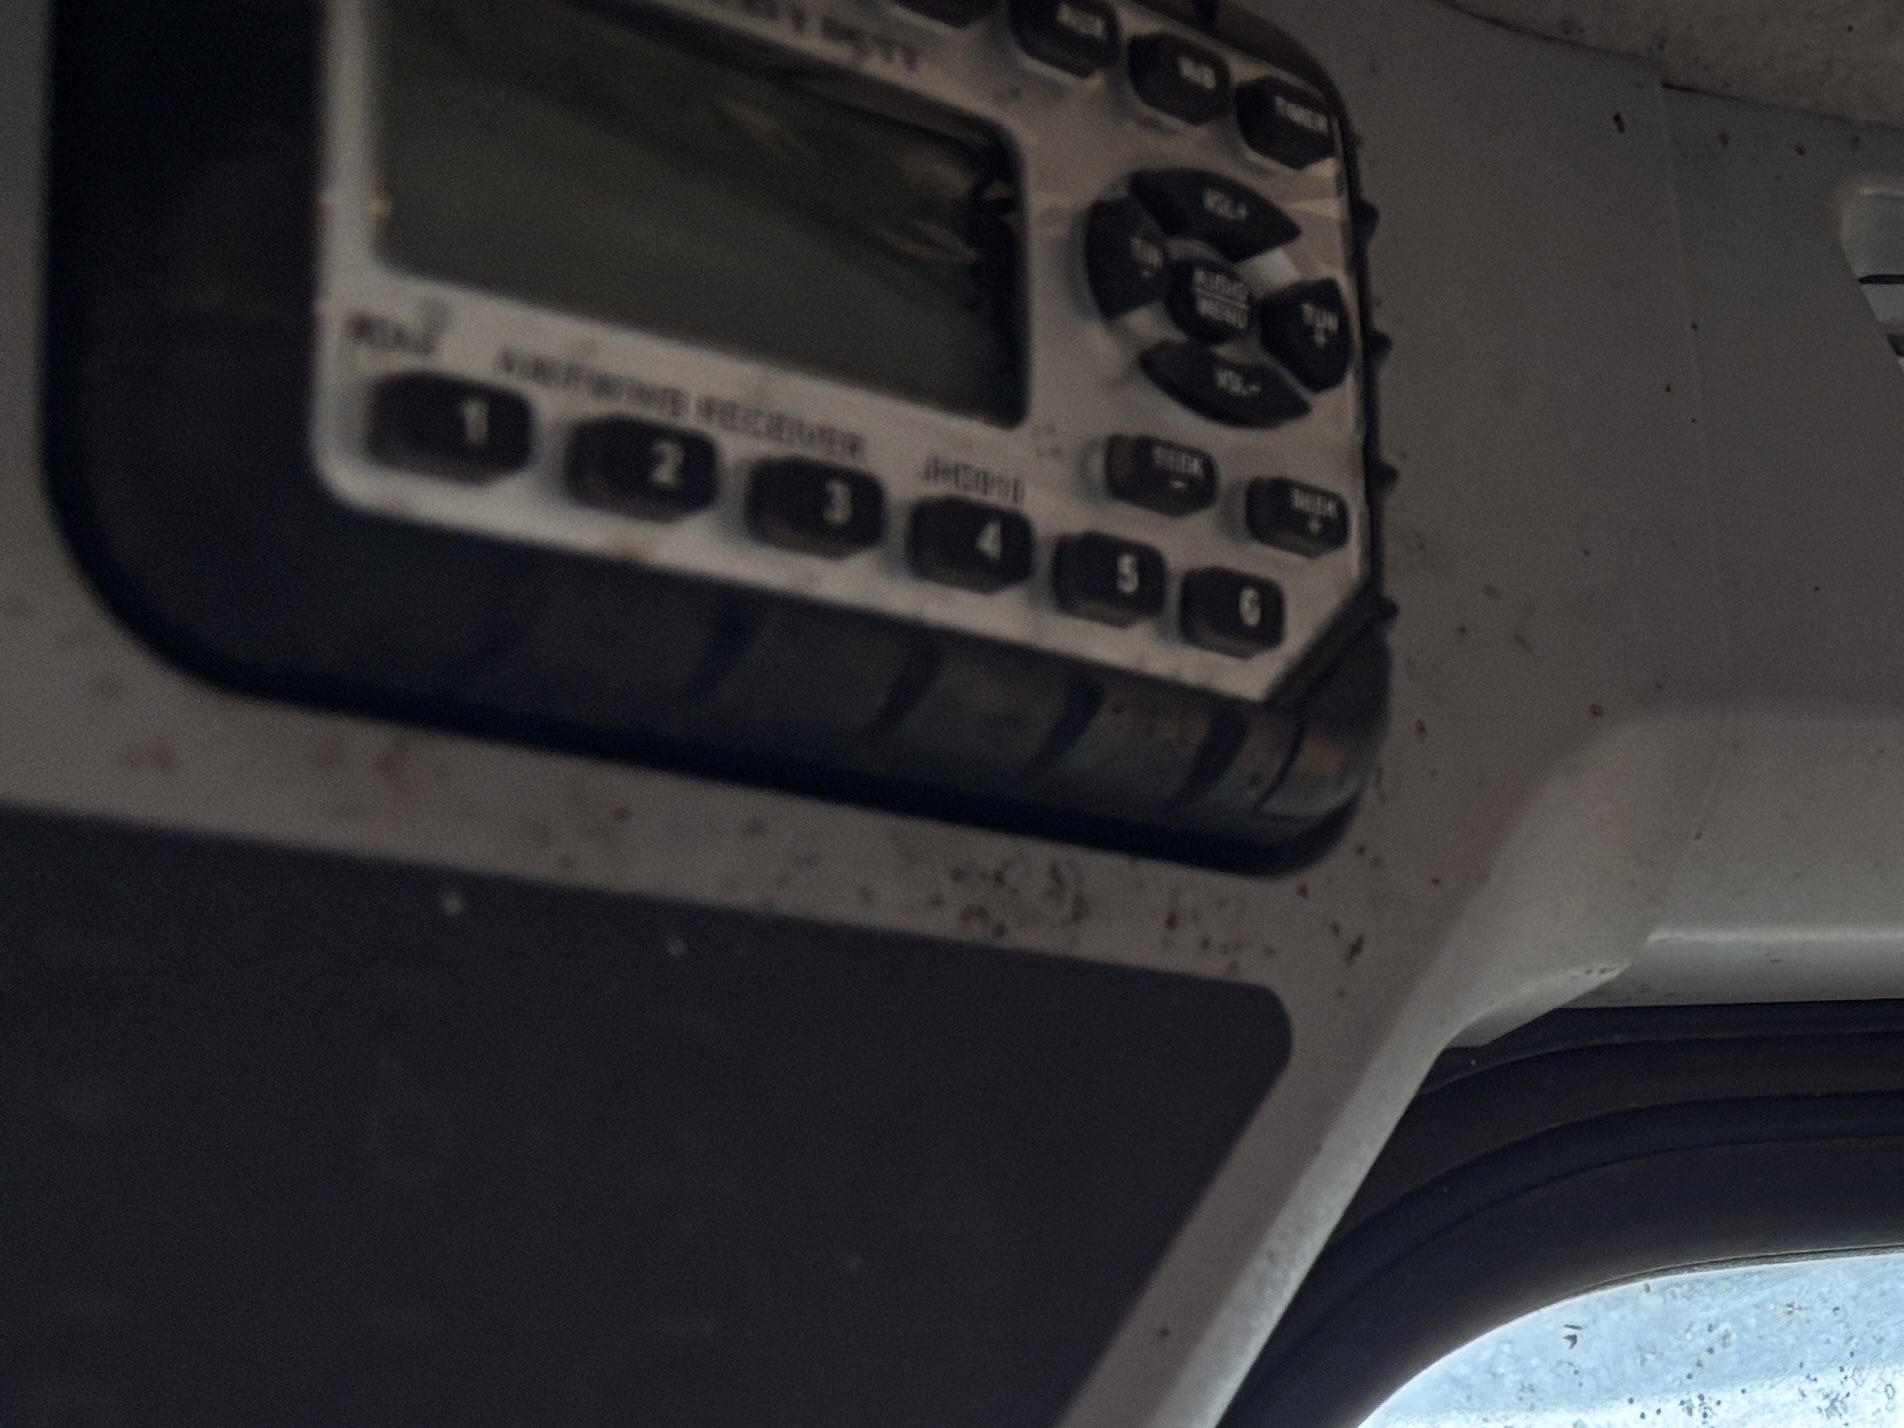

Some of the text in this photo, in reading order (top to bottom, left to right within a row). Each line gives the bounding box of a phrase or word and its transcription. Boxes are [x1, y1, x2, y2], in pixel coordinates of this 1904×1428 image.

[1302, 303, 1339, 332] TUN
[458, 397, 491, 448] 1
[694, 393, 865, 459] RECEIVER
[650, 440, 684, 487] 2
[823, 478, 852, 527] 3
[976, 522, 1001, 560] 4
[1116, 554, 1138, 595] 5
[1238, 587, 1261, 628] 6
